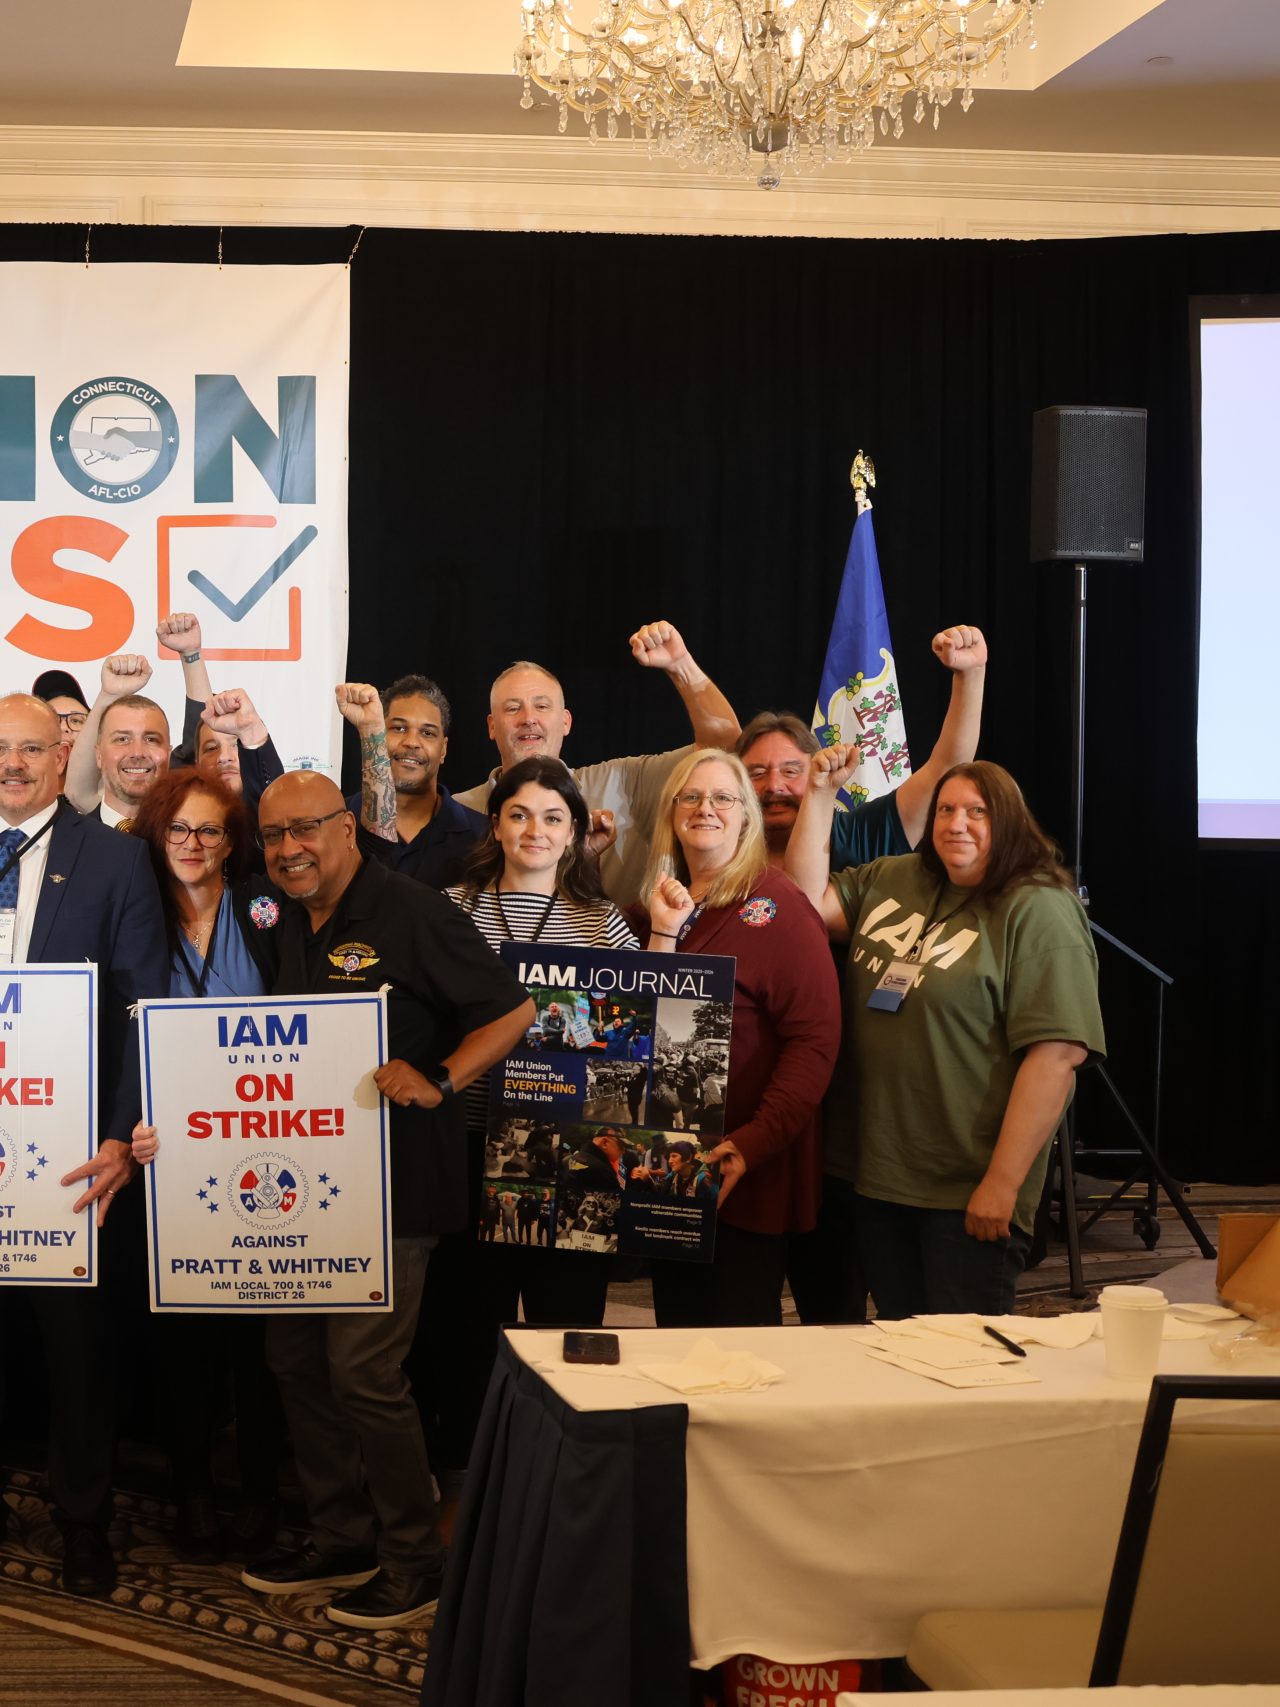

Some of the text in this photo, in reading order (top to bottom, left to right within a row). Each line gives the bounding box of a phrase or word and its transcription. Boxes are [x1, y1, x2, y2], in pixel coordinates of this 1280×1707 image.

[72, 381, 161, 407] CONNECTICUT
[88, 484, 141, 499] AFL-CIO
[859, 898, 979, 970] IAM
[853, 946, 925, 989] UNN
[518, 962, 712, 998] IAM JOURNAL
[218, 1014, 308, 1047] IAM
[228, 1053, 300, 1064] UNION
[505, 1059, 552, 1071] IAM Union
[505, 1069, 564, 1082] Members Put
[235, 1073, 294, 1102] ON
[504, 1079, 577, 1095] EVERYTHING
[503, 1090, 553, 1102] On the Line
[187, 1108, 345, 1139] STRIKE!
[231, 1235, 308, 1248] AGAINST
[2, 1253, 10, 1262] &
[12, 1253, 37, 1263] 1746
[171, 1257, 372, 1275] PRATT & WHITNEY
[210, 1280, 332, 1291] IAM LOCAL 700 & 1746
[238, 1290, 305, 1300] DISTRICT 26
[736, 1655, 840, 1692] GROWN
